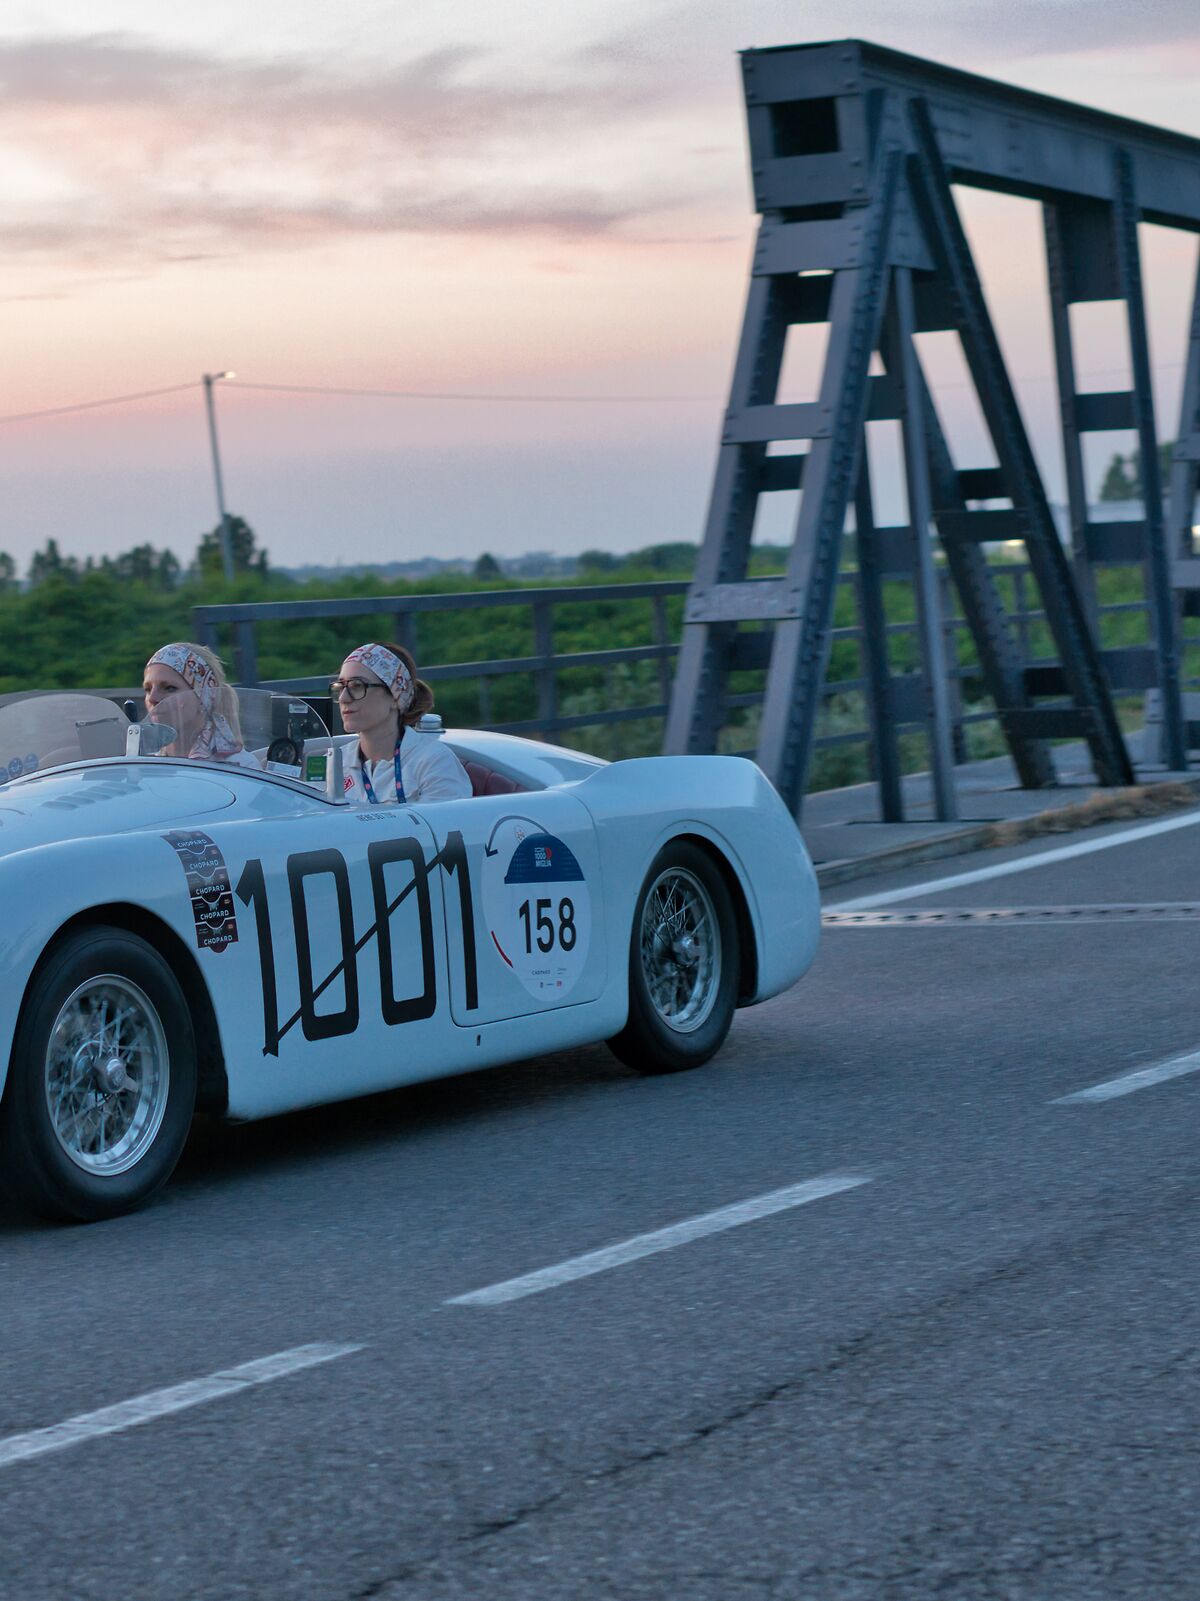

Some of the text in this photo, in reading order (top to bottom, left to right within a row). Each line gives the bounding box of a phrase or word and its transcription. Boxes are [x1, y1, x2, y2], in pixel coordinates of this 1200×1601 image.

[177, 839, 208, 848] CHOPARD
[189, 859, 219, 870] CHOPARD
[195, 884, 225, 895] CHOPARD
[200, 909, 230, 920] CHOPARD
[518, 897, 577, 954] 158
[203, 934, 233, 945] CHOPARD
[235, 831, 478, 1057] 1001
